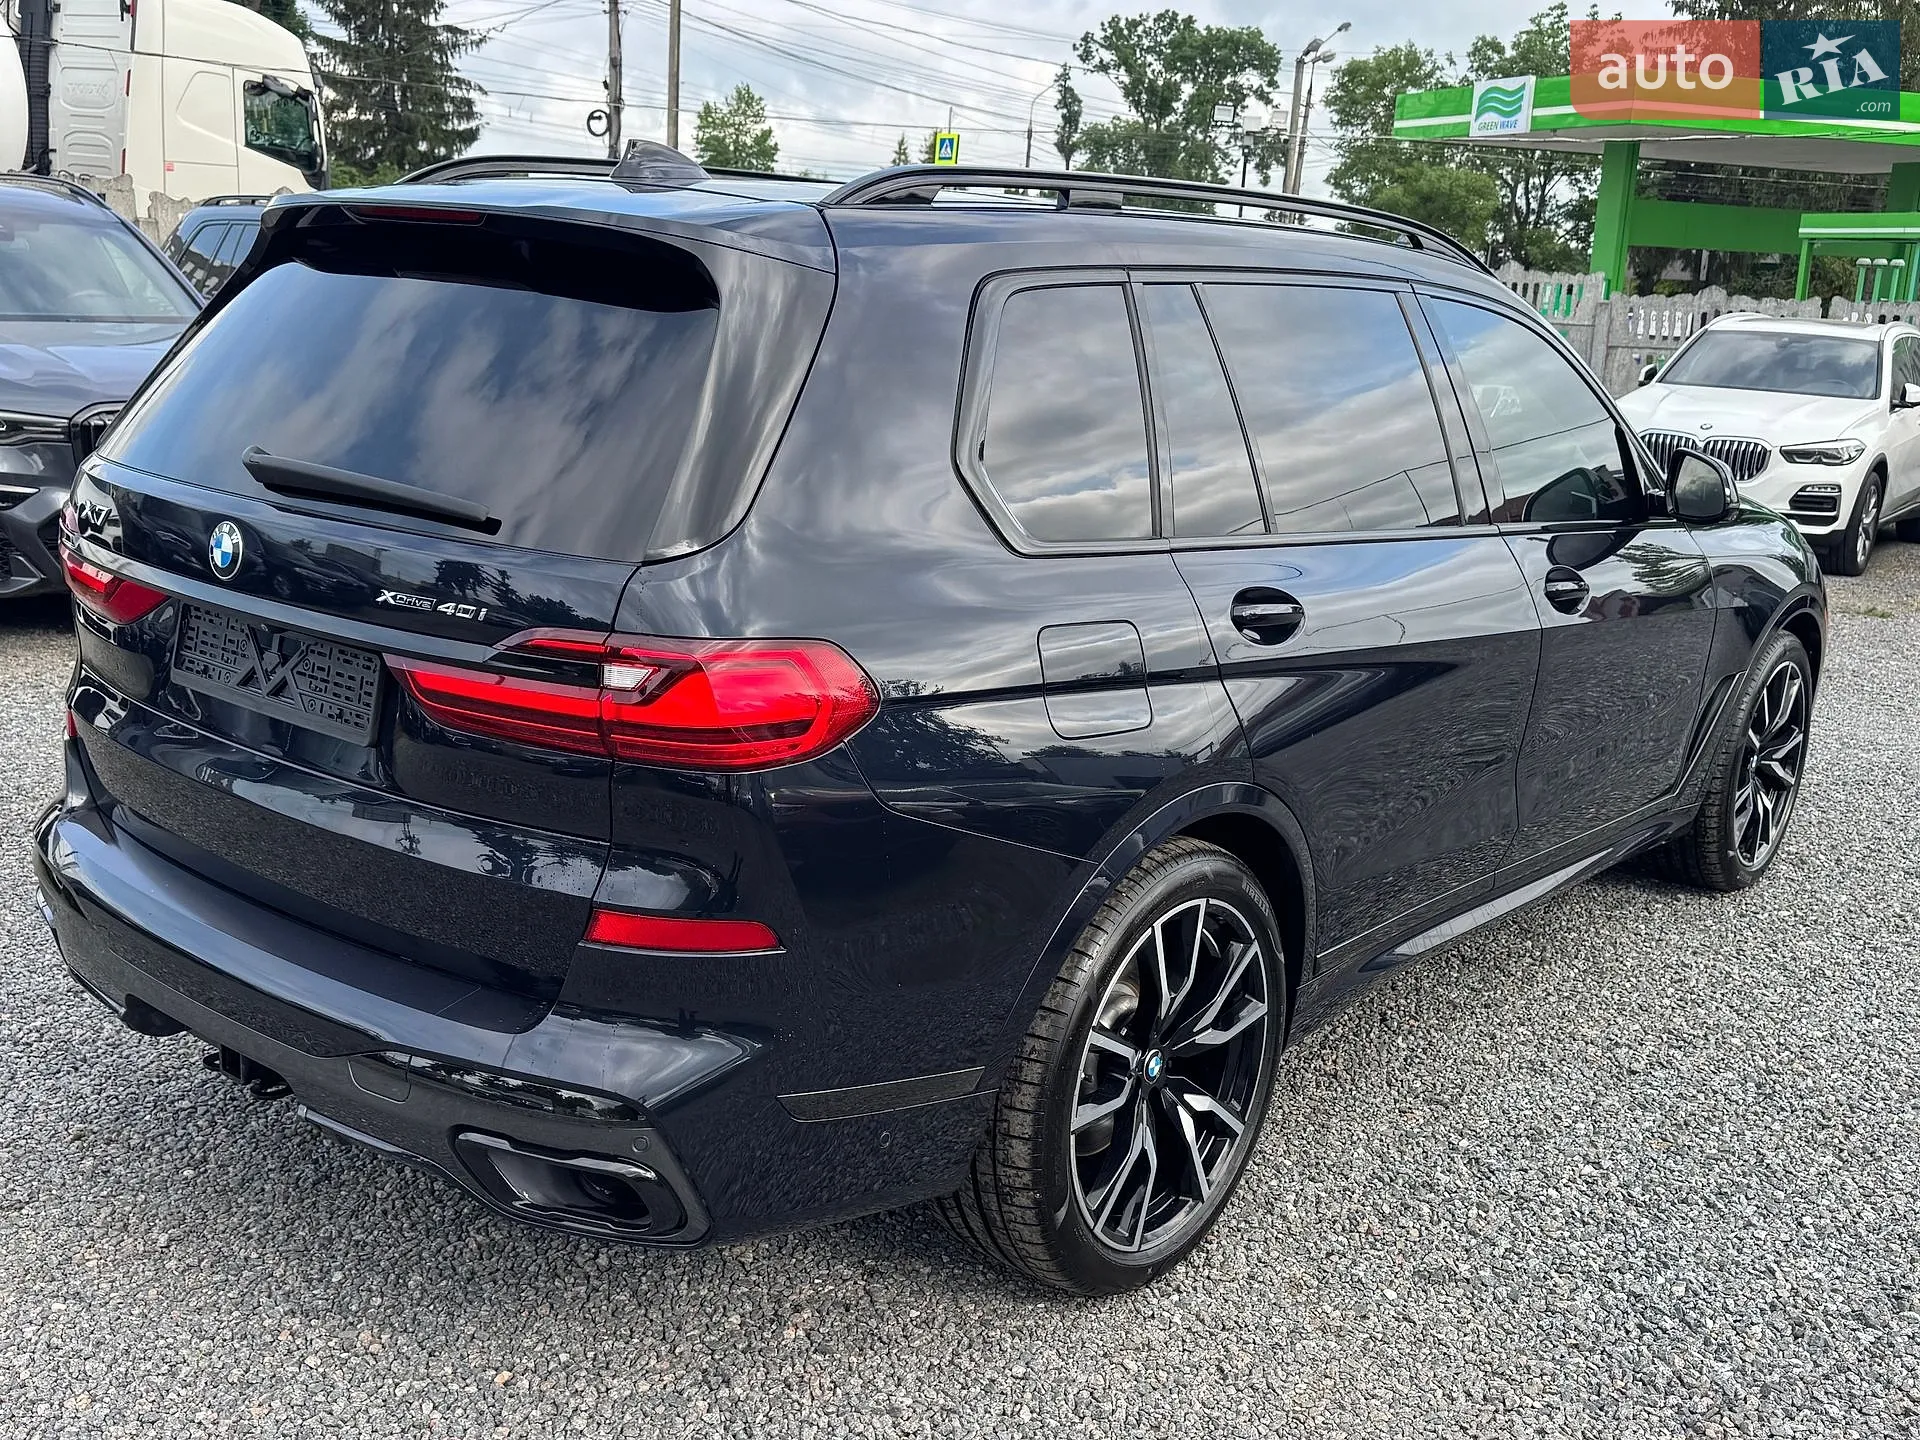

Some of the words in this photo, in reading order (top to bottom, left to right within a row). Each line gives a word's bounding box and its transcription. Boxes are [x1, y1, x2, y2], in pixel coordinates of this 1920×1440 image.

[1477, 120, 1499, 131] GREEN
[1499, 119, 1518, 129] WAVE
[80, 500, 110, 526] X7
[436, 602, 488, 621] 40i
